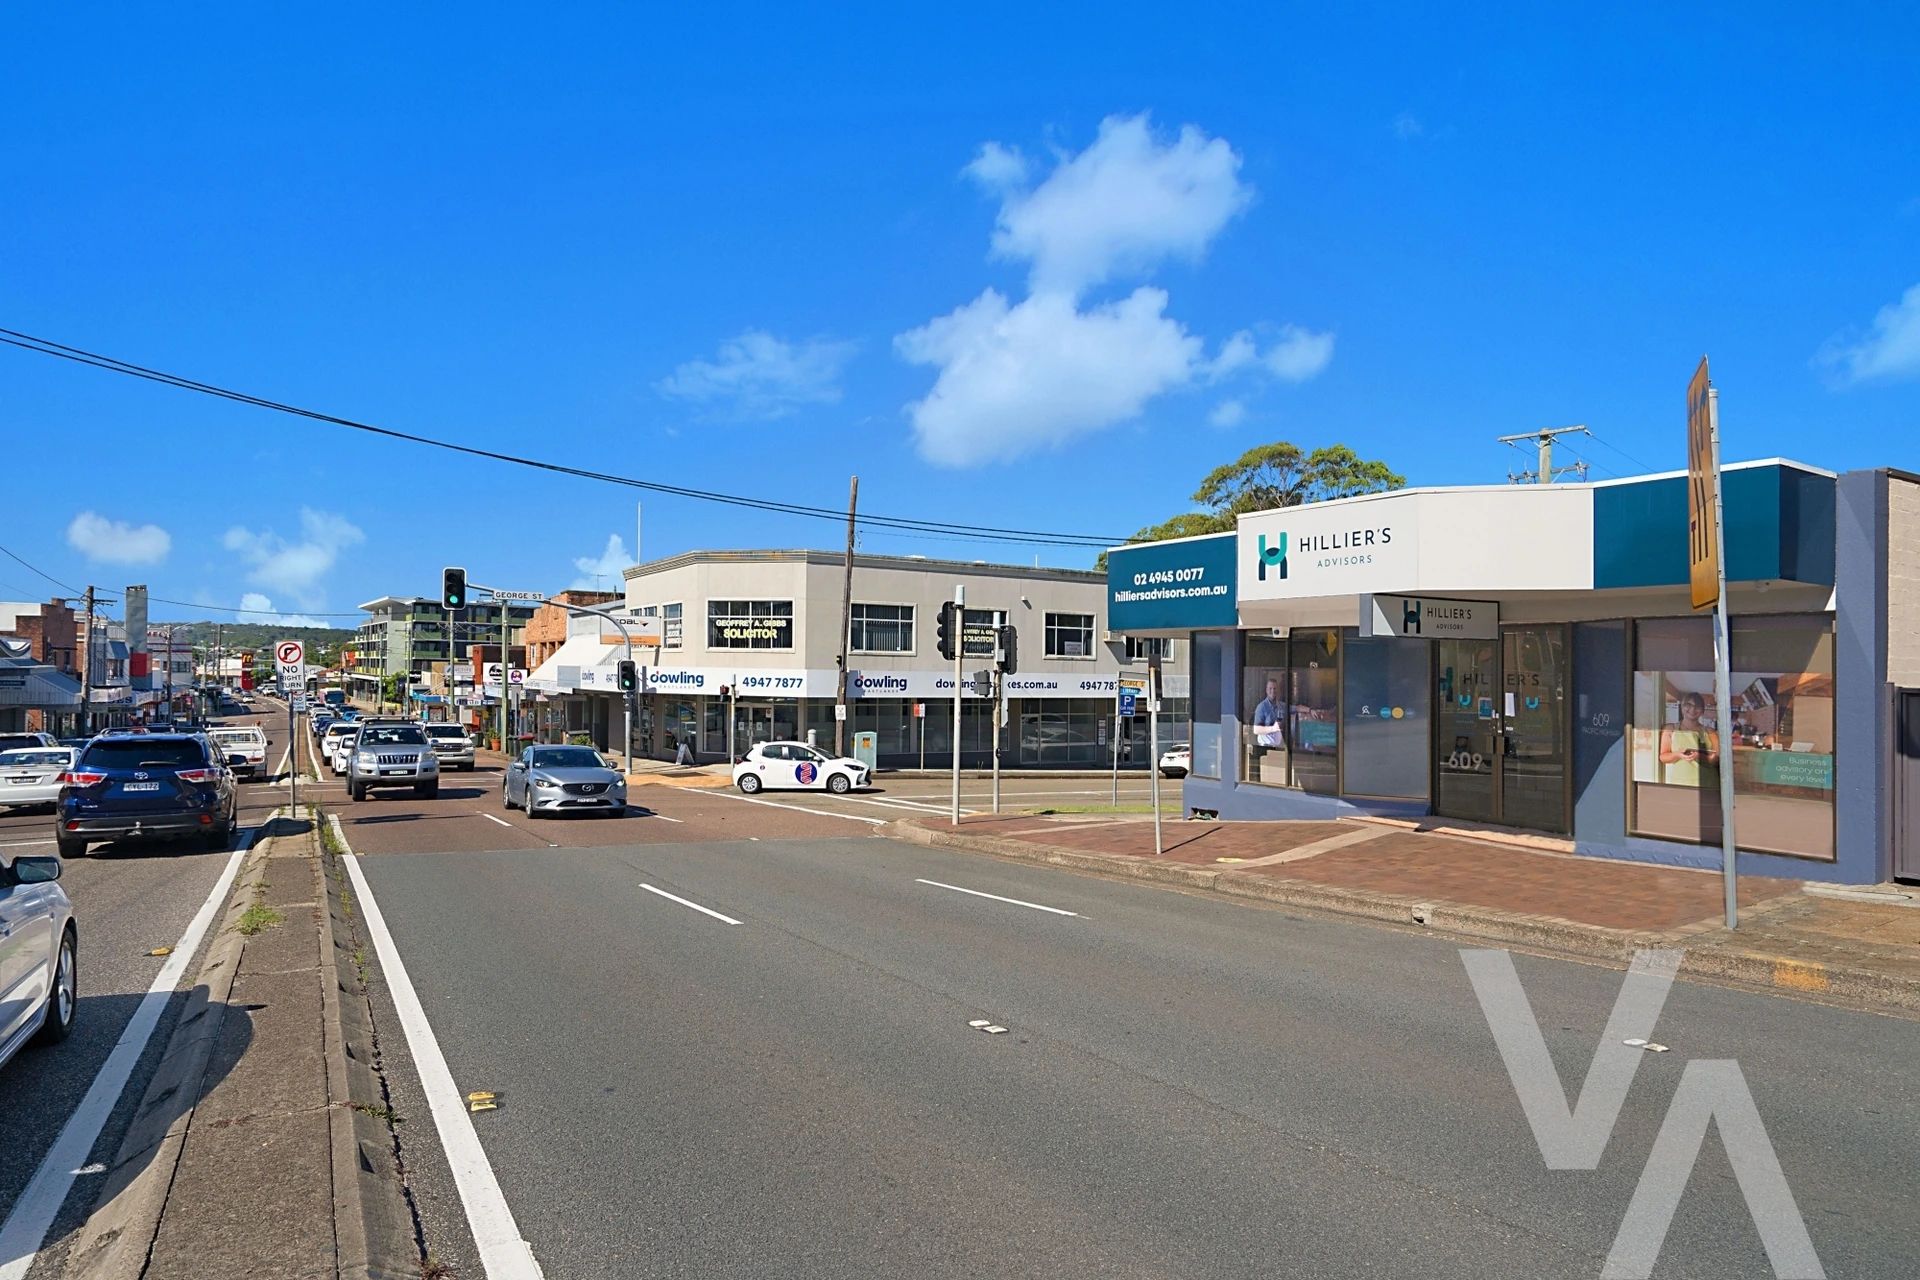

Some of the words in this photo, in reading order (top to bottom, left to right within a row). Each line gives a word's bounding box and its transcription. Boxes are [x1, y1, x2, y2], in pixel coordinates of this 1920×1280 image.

[1300, 527, 1391, 552] HILLIER'S
[1317, 554, 1372, 568] ADVISORS
[1134, 573, 1147, 586] 02
[1149, 570, 1174, 584] 4945
[1176, 567, 1204, 582] 0077
[1115, 585, 1228, 602] hilliersadvisors.com.au
[1427, 606, 1472, 620] HILLIER'S
[1436, 623, 1464, 631] ADVISORS
[723, 628, 778, 639] SOLICITOR
[282, 665, 298, 673] NO
[650, 671, 704, 687] dowling
[742, 677, 772, 687] 4947
[775, 678, 803, 688] 7877
[854, 675, 907, 691] dowling
[1080, 681, 1102, 690] 4947
[1124, 696, 1132, 706] P
[1592, 713, 1610, 727] 609
[1449, 751, 1483, 771] 609
[1788, 756, 1827, 766] Business
[1775, 765, 1812, 775] advisory
[1780, 774, 1804, 782] every
[1806, 775, 1827, 783] level
